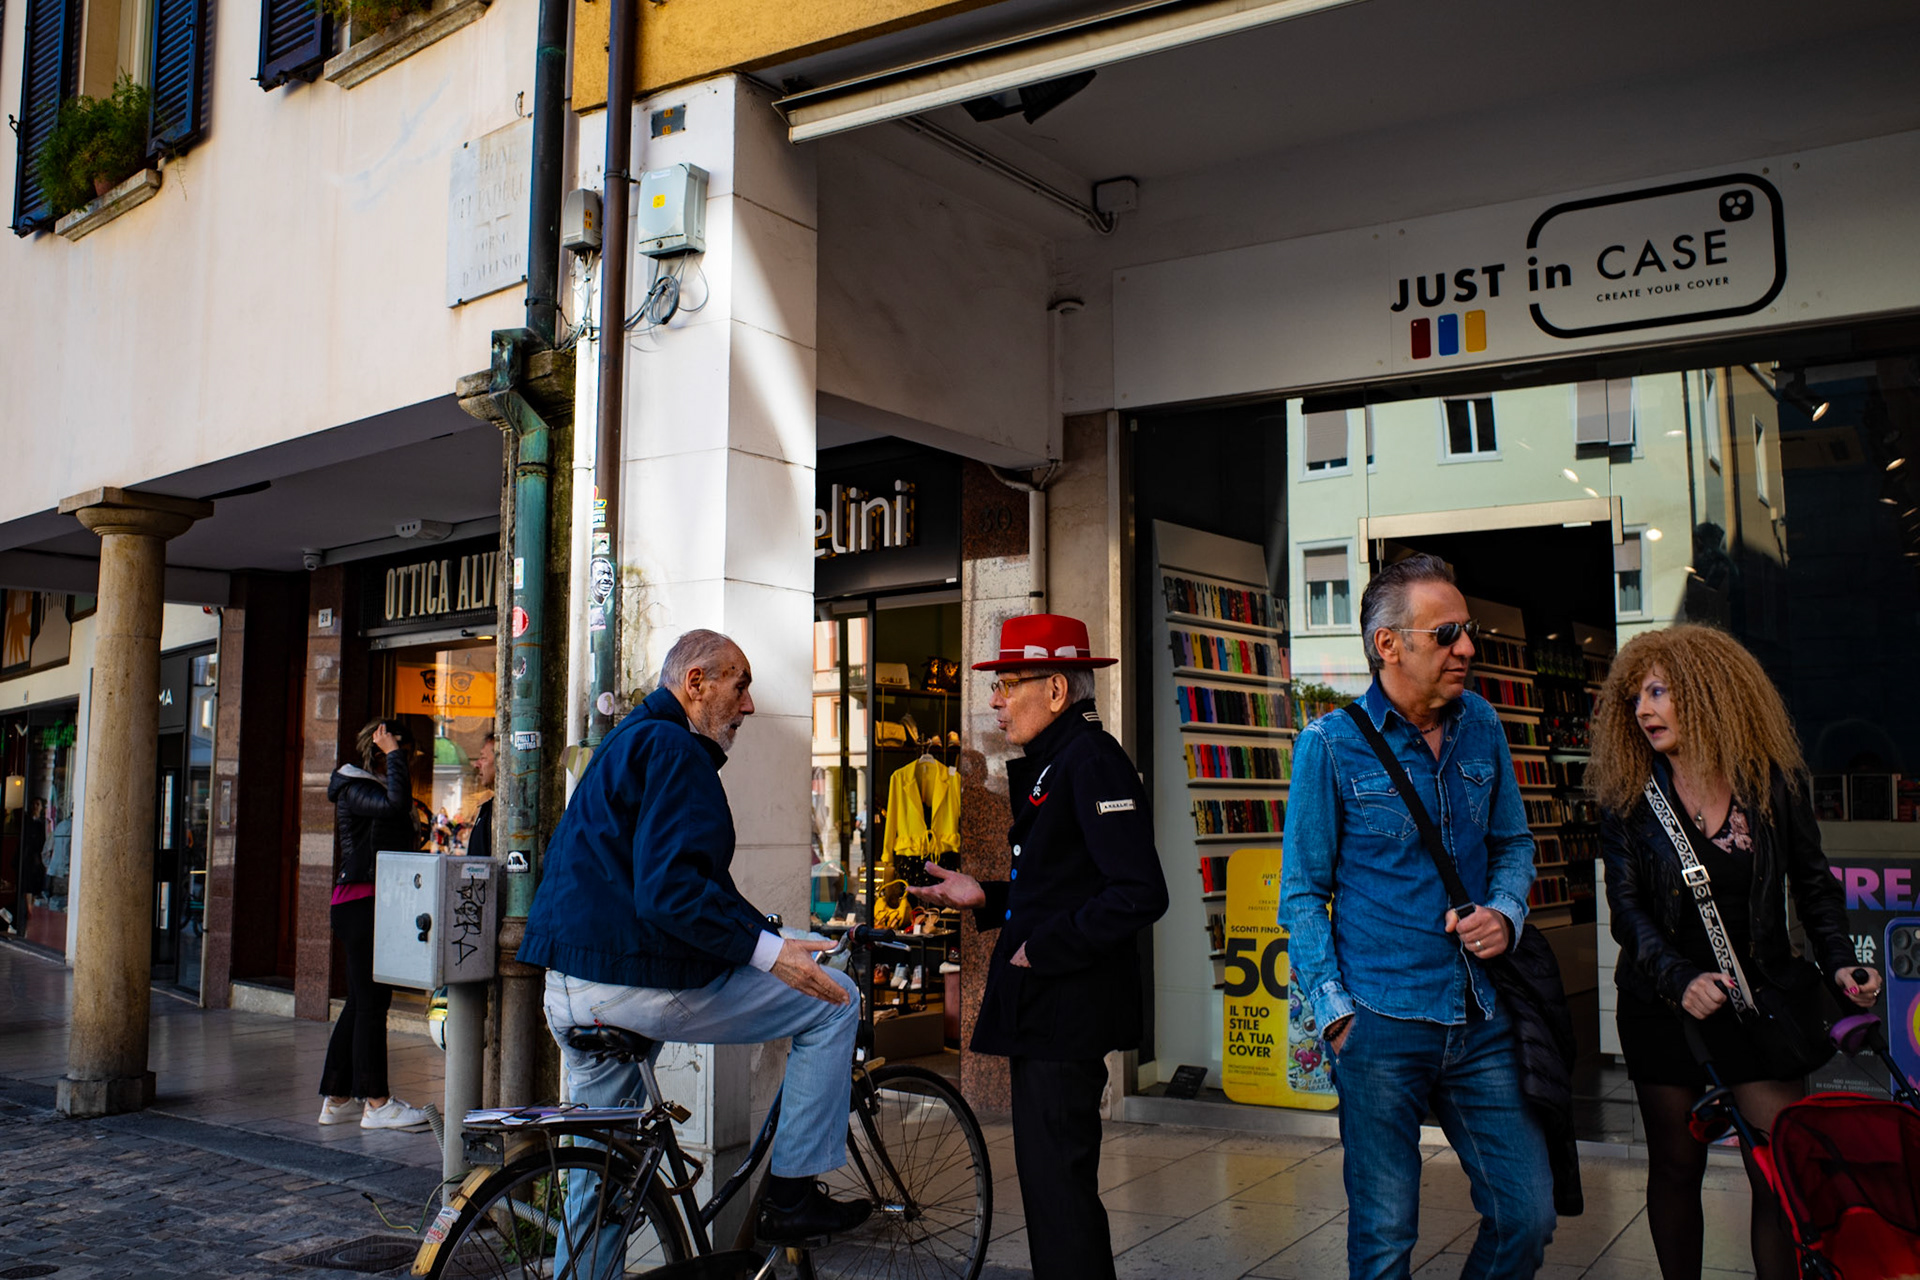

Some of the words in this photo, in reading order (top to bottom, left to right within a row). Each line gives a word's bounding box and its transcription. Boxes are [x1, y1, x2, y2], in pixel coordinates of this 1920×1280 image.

[1390, 263, 1506, 312] JUST
[1528, 256, 1572, 291] in
[1596, 228, 1728, 280] CASE
[1596, 288, 1641, 303] CREATE
[1646, 282, 1682, 296] YOUR
[1688, 276, 1730, 291] COVER
[385, 560, 450, 621] OTTICA
[421, 692, 472, 706] MOSCOT
[1648, 792, 1676, 828] KORS
[1708, 925, 1732, 970] KORS
[1229, 1006, 1240, 1018] IL
[1242, 1006, 1270, 1018] TUO
[1228, 1018, 1260, 1031] STILE
[1228, 1031, 1246, 1043] LA
[1248, 1032, 1274, 1045] TUA
[1228, 1044, 1272, 1058] COVER
